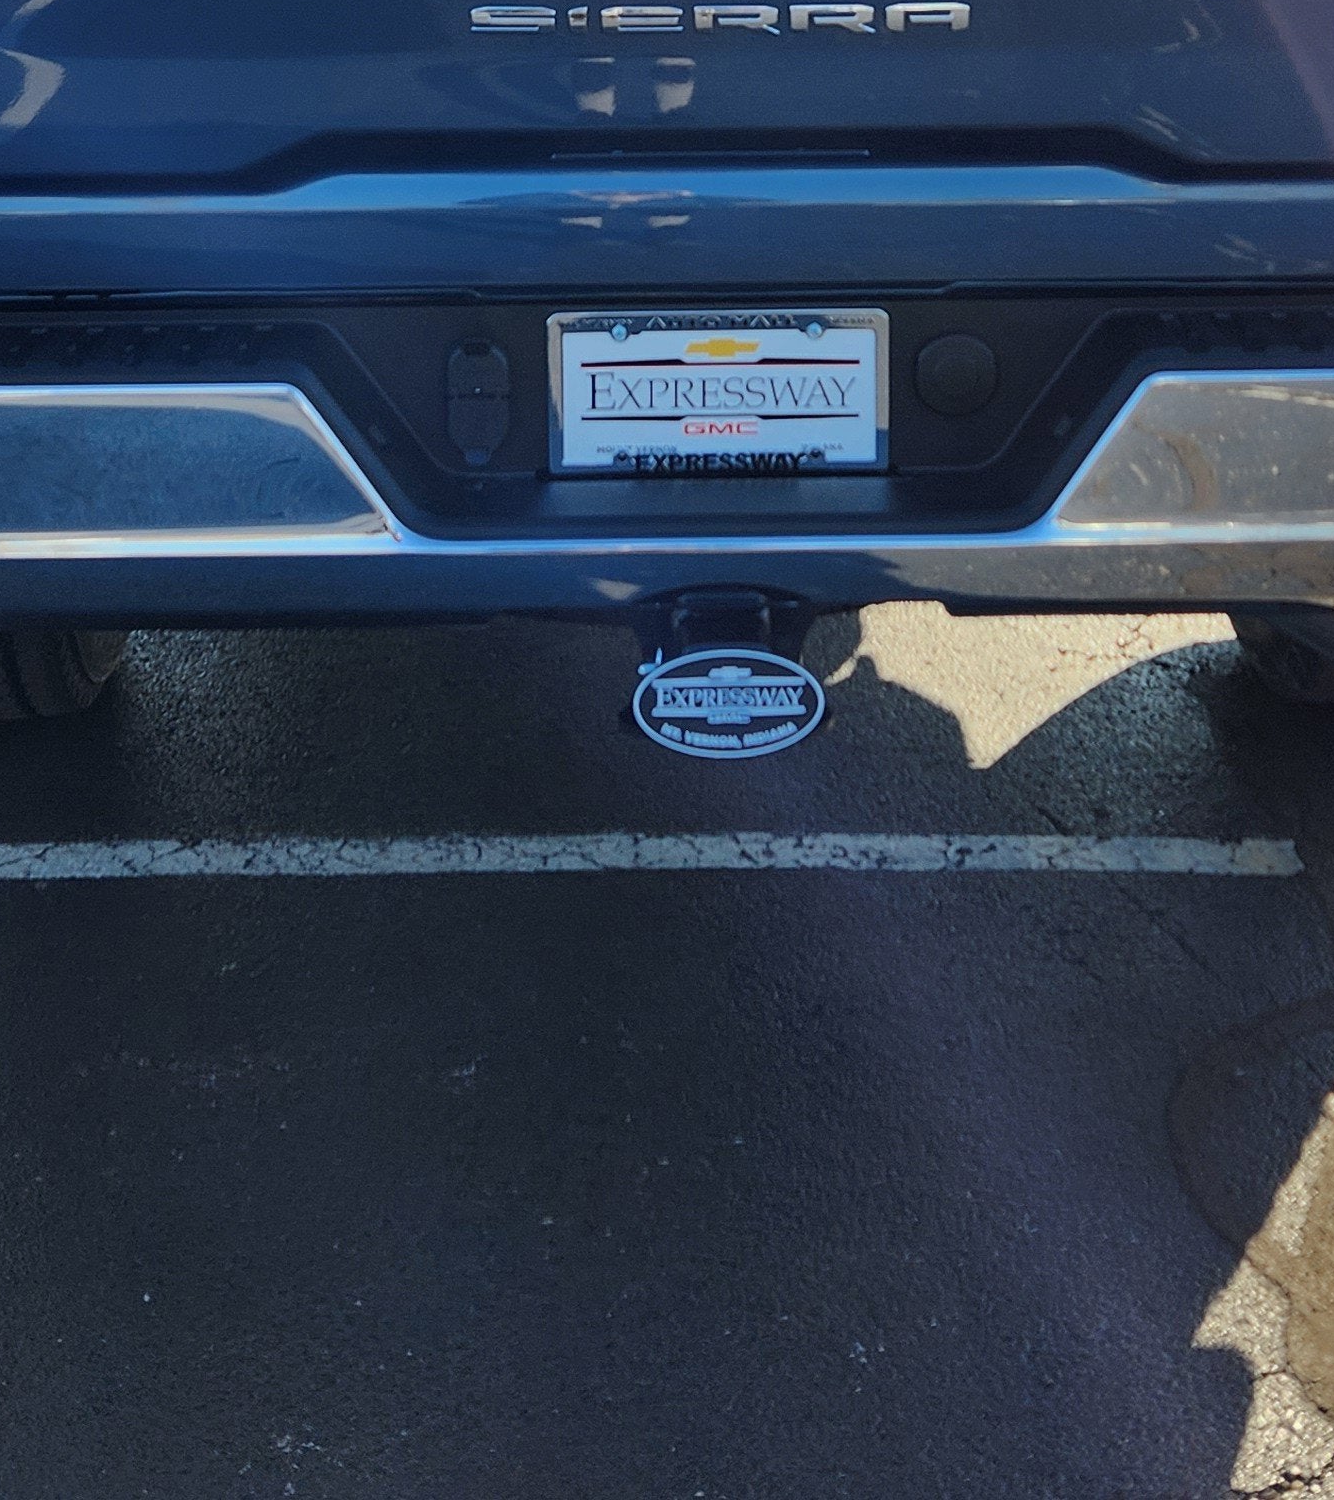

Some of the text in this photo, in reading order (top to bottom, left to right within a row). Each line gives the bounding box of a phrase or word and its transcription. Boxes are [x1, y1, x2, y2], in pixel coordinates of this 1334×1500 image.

[470, 4, 971, 35] SIERRA
[586, 372, 856, 410] EXPRESSWAY
[683, 422, 759, 436] GMC
[634, 452, 806, 472] EXPRESSWAY
[656, 687, 803, 708] EXPRESSWAY
